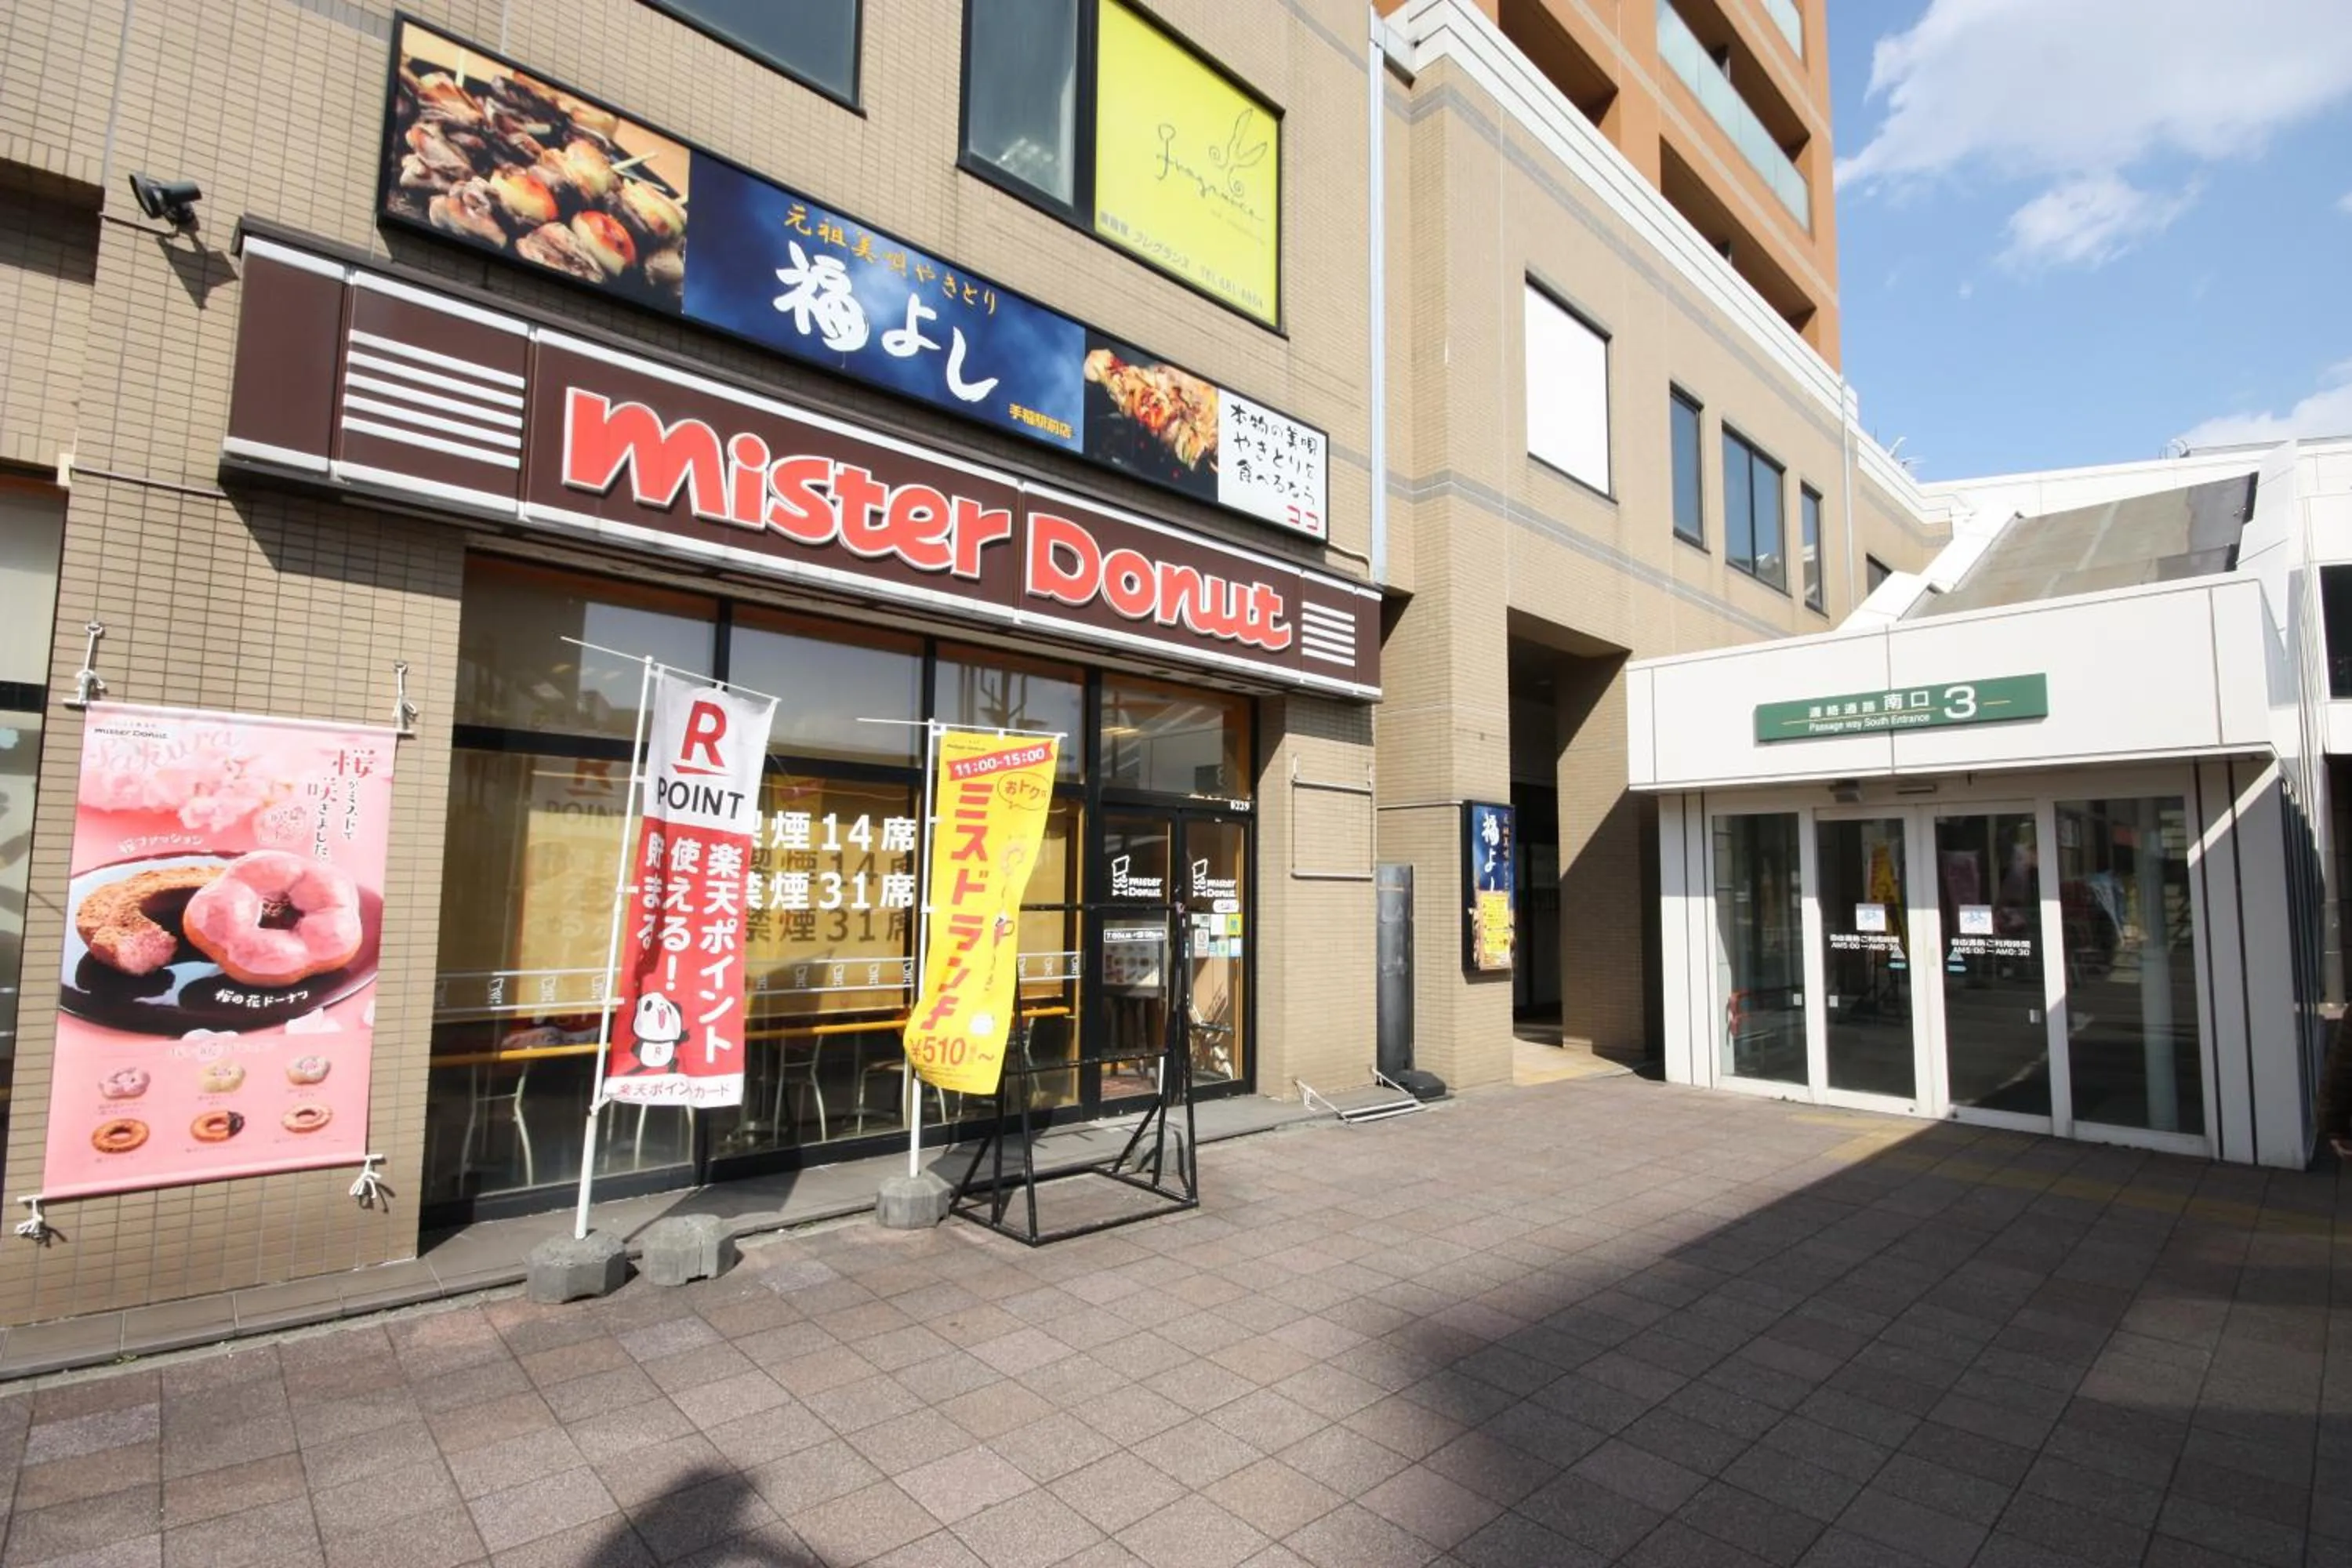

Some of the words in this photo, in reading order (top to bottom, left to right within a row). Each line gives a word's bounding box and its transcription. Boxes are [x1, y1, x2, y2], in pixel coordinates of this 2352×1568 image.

[785, 203, 997, 314] 元祖美唄やきとり
[773, 240, 1000, 402] 福よし
[1287, 505, 1319, 531] ココ
[1025, 511, 1293, 652] Donut
[1864, 716, 1889, 728] South
[1891, 714, 1930, 725] Entrance
[1943, 685, 1977, 720] 3
[681, 700, 727, 768] R
[657, 776, 745, 819] POINT
[753, 810, 916, 852] 煙14席
[920, 782, 994, 1030] ミスドランチ
[699, 842, 743, 1063] 楽天ポイント
[215, 989, 309, 1008] 桜の花ドーナツ
[909, 1036, 966, 1066] ¥510
